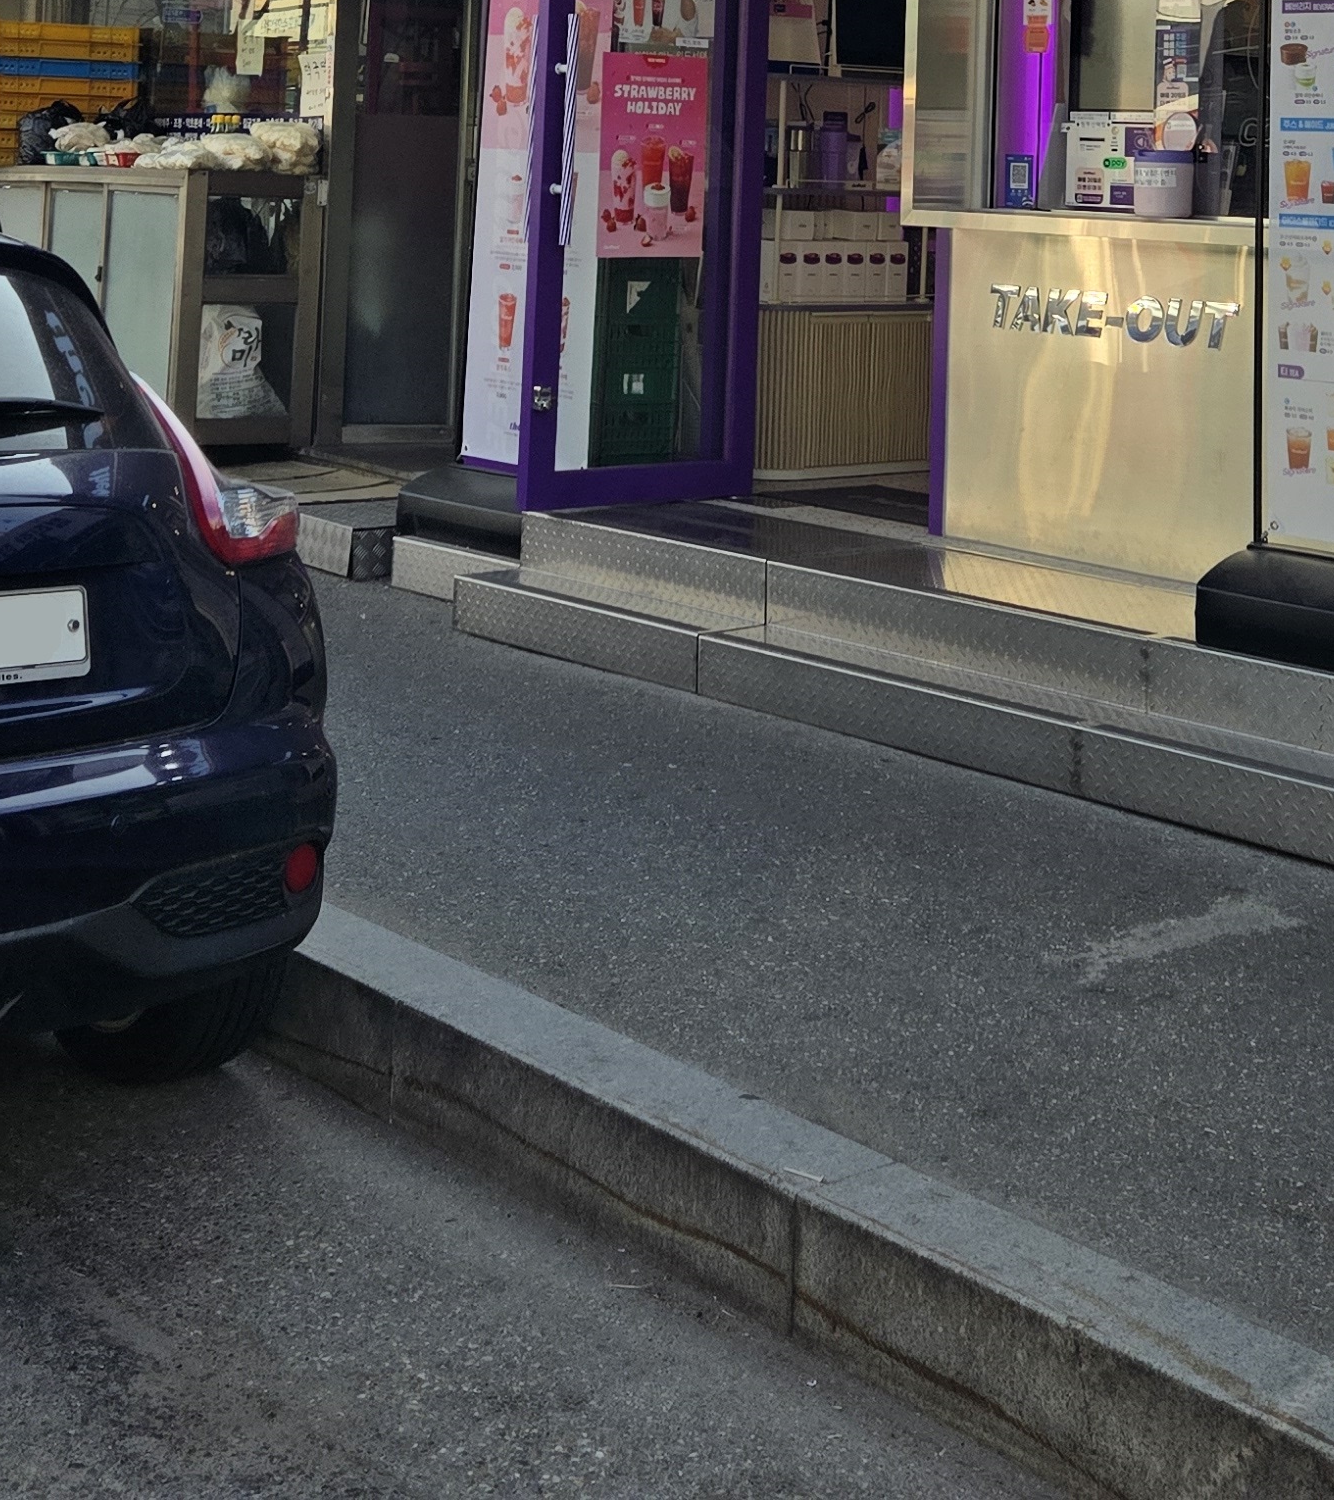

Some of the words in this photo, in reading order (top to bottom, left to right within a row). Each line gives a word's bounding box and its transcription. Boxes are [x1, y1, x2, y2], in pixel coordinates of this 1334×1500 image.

[614, 84, 697, 101] STRAWBERRY
[627, 100, 683, 116] HOLIDAY
[990, 283, 1242, 351] TAKE-OUT
